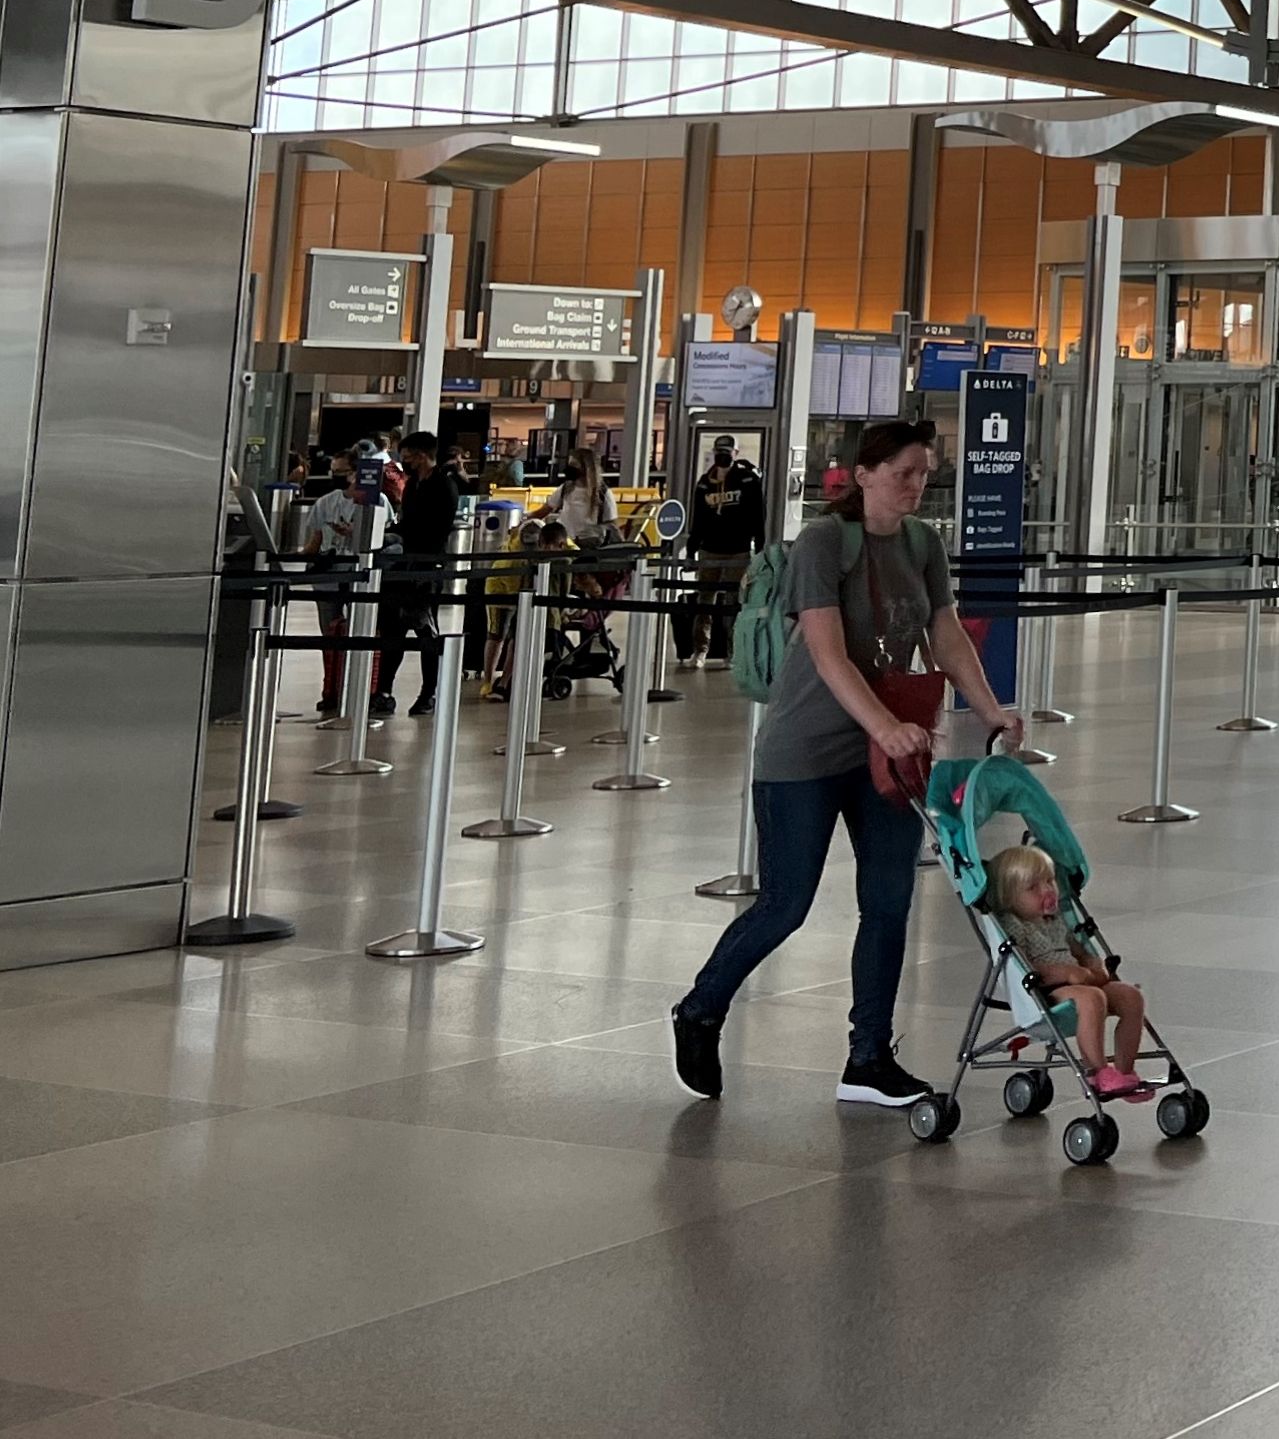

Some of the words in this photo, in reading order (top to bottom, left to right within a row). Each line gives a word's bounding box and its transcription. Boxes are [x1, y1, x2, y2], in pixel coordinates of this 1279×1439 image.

[348, 285, 360, 294] All
[361, 286, 386, 296] Gates
[329, 300, 366, 311] Oversize
[368, 302, 385, 313] Bag
[553, 297, 579, 308] Down
[581, 298, 593, 309] to:
[347, 313, 384, 323] Drop-off
[547, 311, 566, 323] Bag
[566, 312, 592, 323] Claim
[513, 324, 547, 335] Ground
[549, 325, 592, 338] Transport
[497, 337, 555, 349] International
[555, 339, 590, 350] Arrivals
[694, 351, 730, 361] Modified
[529, 379, 539, 394] 9
[983, 380, 1014, 390] DELTA
[967, 451, 1022, 462] SELF-TAGGED
[973, 463, 991, 474] BAG
[992, 463, 1015, 474] DROP
